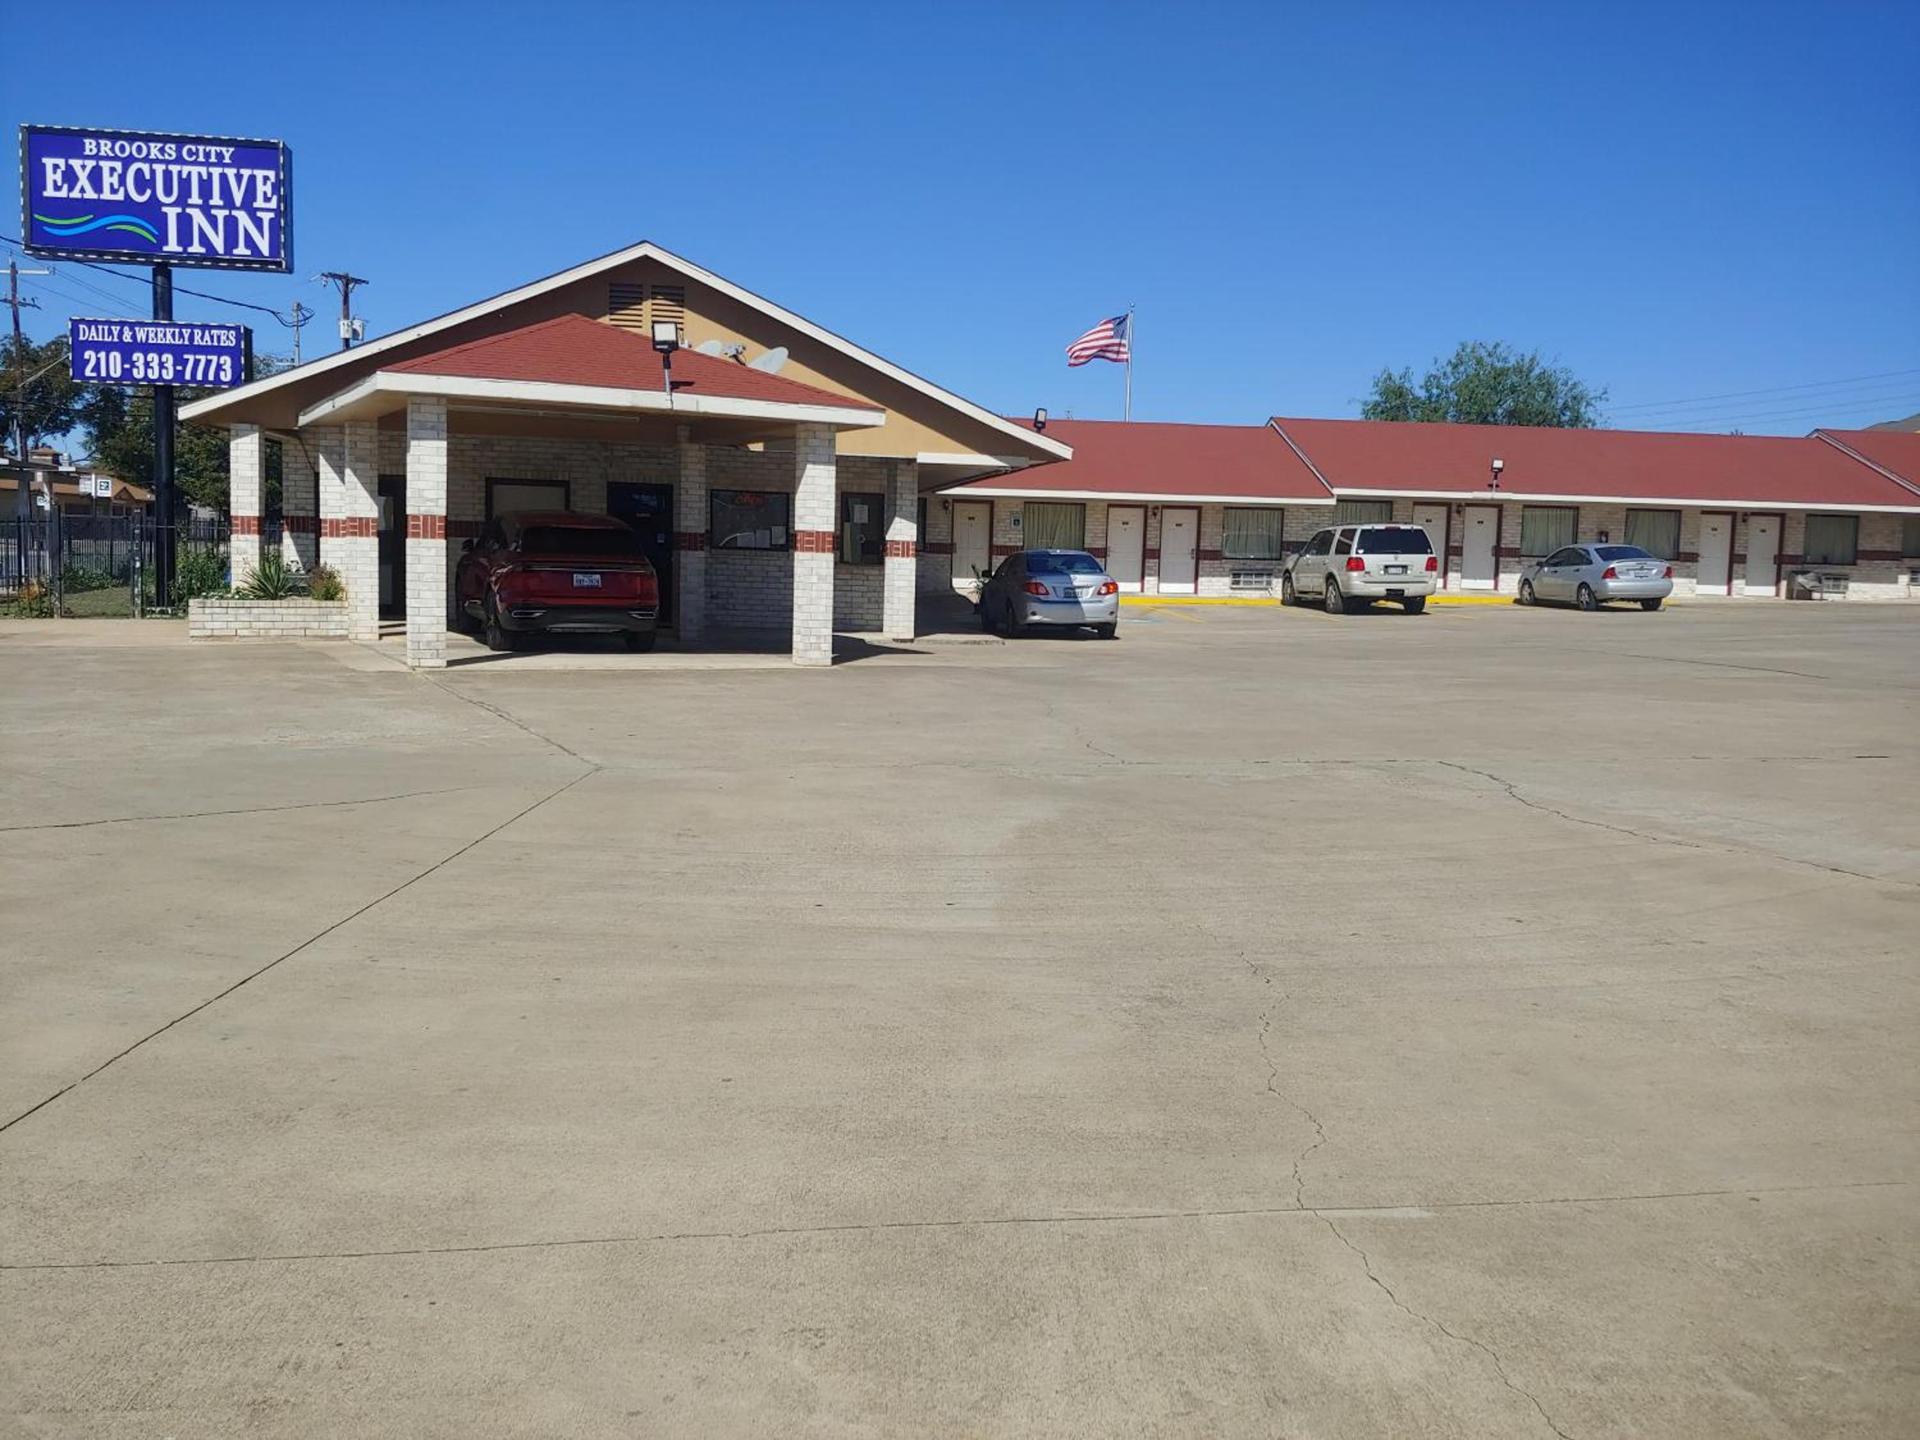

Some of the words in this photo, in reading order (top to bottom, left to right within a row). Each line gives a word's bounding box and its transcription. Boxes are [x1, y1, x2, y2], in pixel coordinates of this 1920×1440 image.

[83, 138, 177, 160] BROOKS
[182, 145, 235, 164] CITY
[41, 157, 278, 209] EXECUTIVE
[161, 206, 276, 257] INN
[78, 324, 119, 341] DAILY
[122, 326, 133, 342] &
[134, 327, 191, 344] WEEKLY
[193, 329, 236, 347] RATES
[83, 350, 233, 382] 210-333-7773
